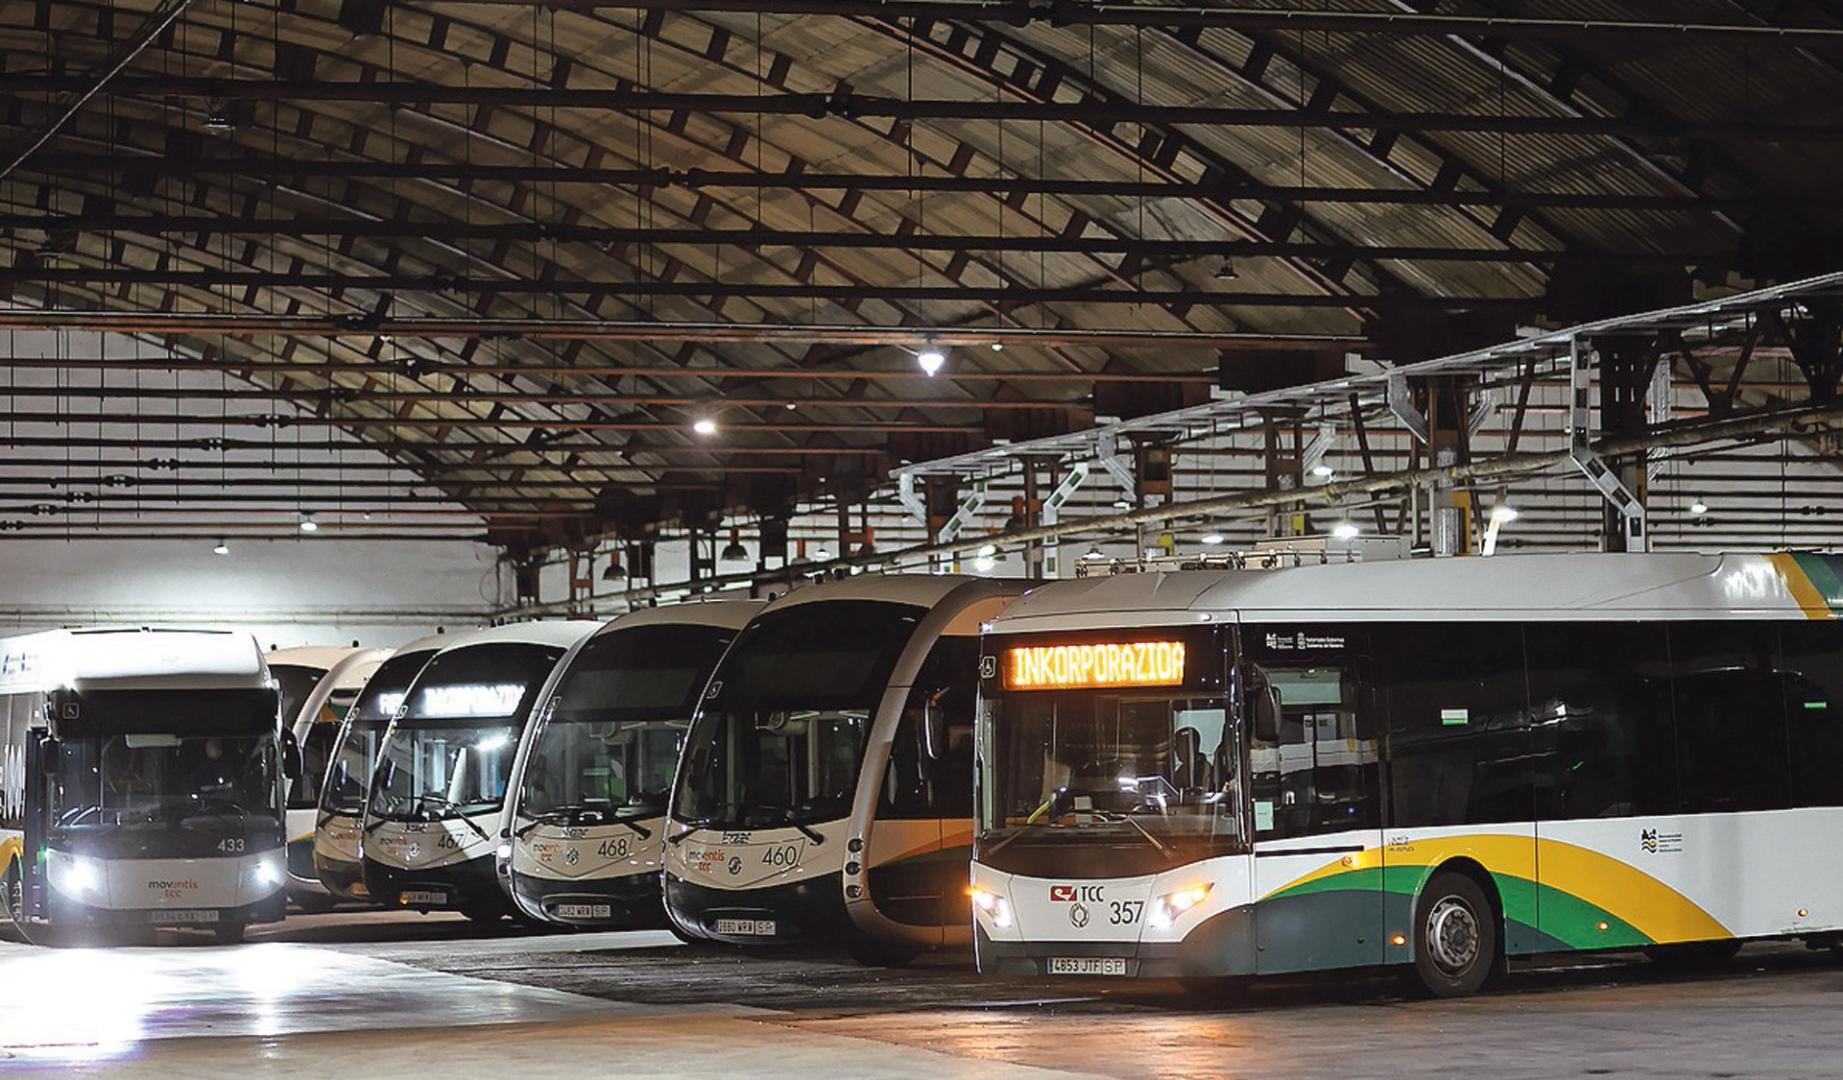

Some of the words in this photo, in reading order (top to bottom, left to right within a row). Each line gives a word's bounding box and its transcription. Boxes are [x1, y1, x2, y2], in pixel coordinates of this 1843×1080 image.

[1014, 641, 1185, 686] INKORPORAZIOA
[217, 838, 245, 852] 433
[437, 833, 465, 849] 467
[597, 838, 628, 857] 468
[762, 845, 797, 866] 460
[1081, 886, 1104, 902] TCC
[1110, 901, 1144, 924] 357
[1054, 959, 1079, 973] 4853
[1081, 959, 1100, 973] JTF
[1104, 961, 1122, 973] SP
